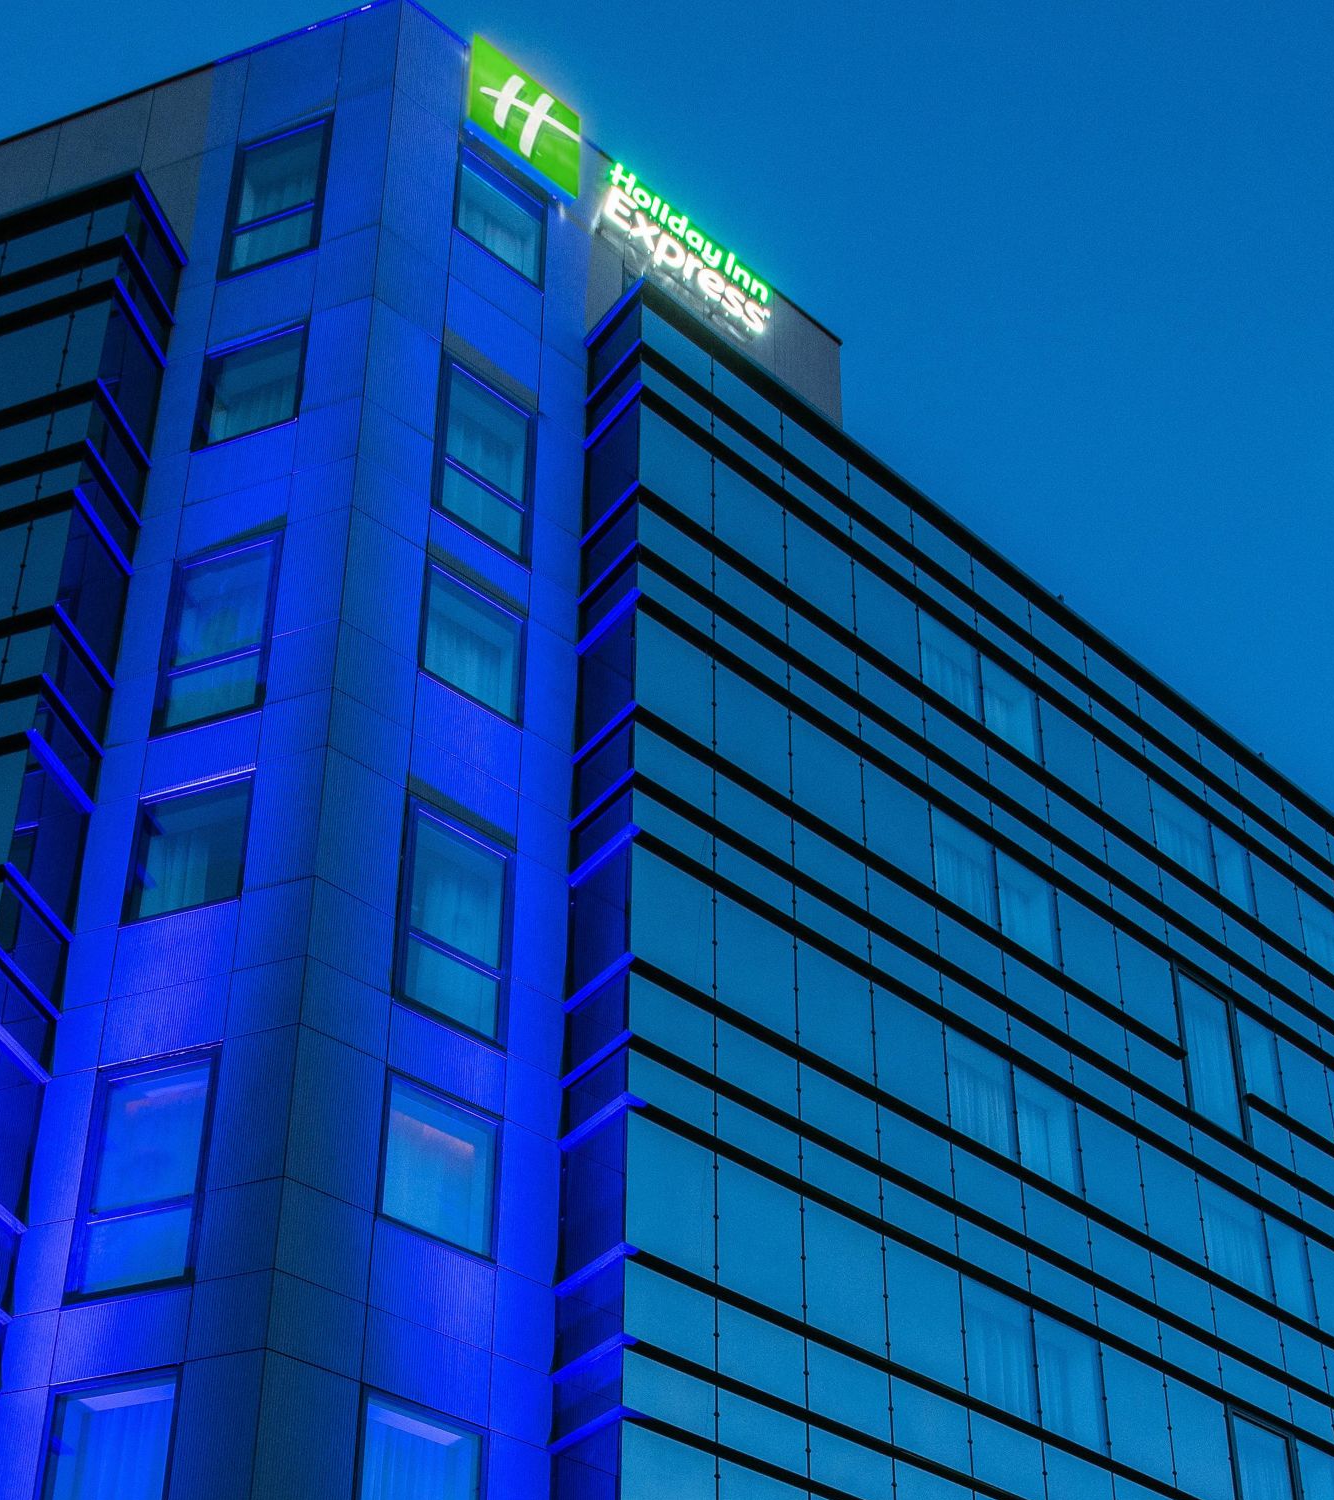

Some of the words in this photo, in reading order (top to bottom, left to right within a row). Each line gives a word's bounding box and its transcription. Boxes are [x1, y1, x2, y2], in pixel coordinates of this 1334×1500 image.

[604, 186, 770, 335] Express
[610, 162, 723, 269] Holiday
[724, 251, 770, 304] Inn
